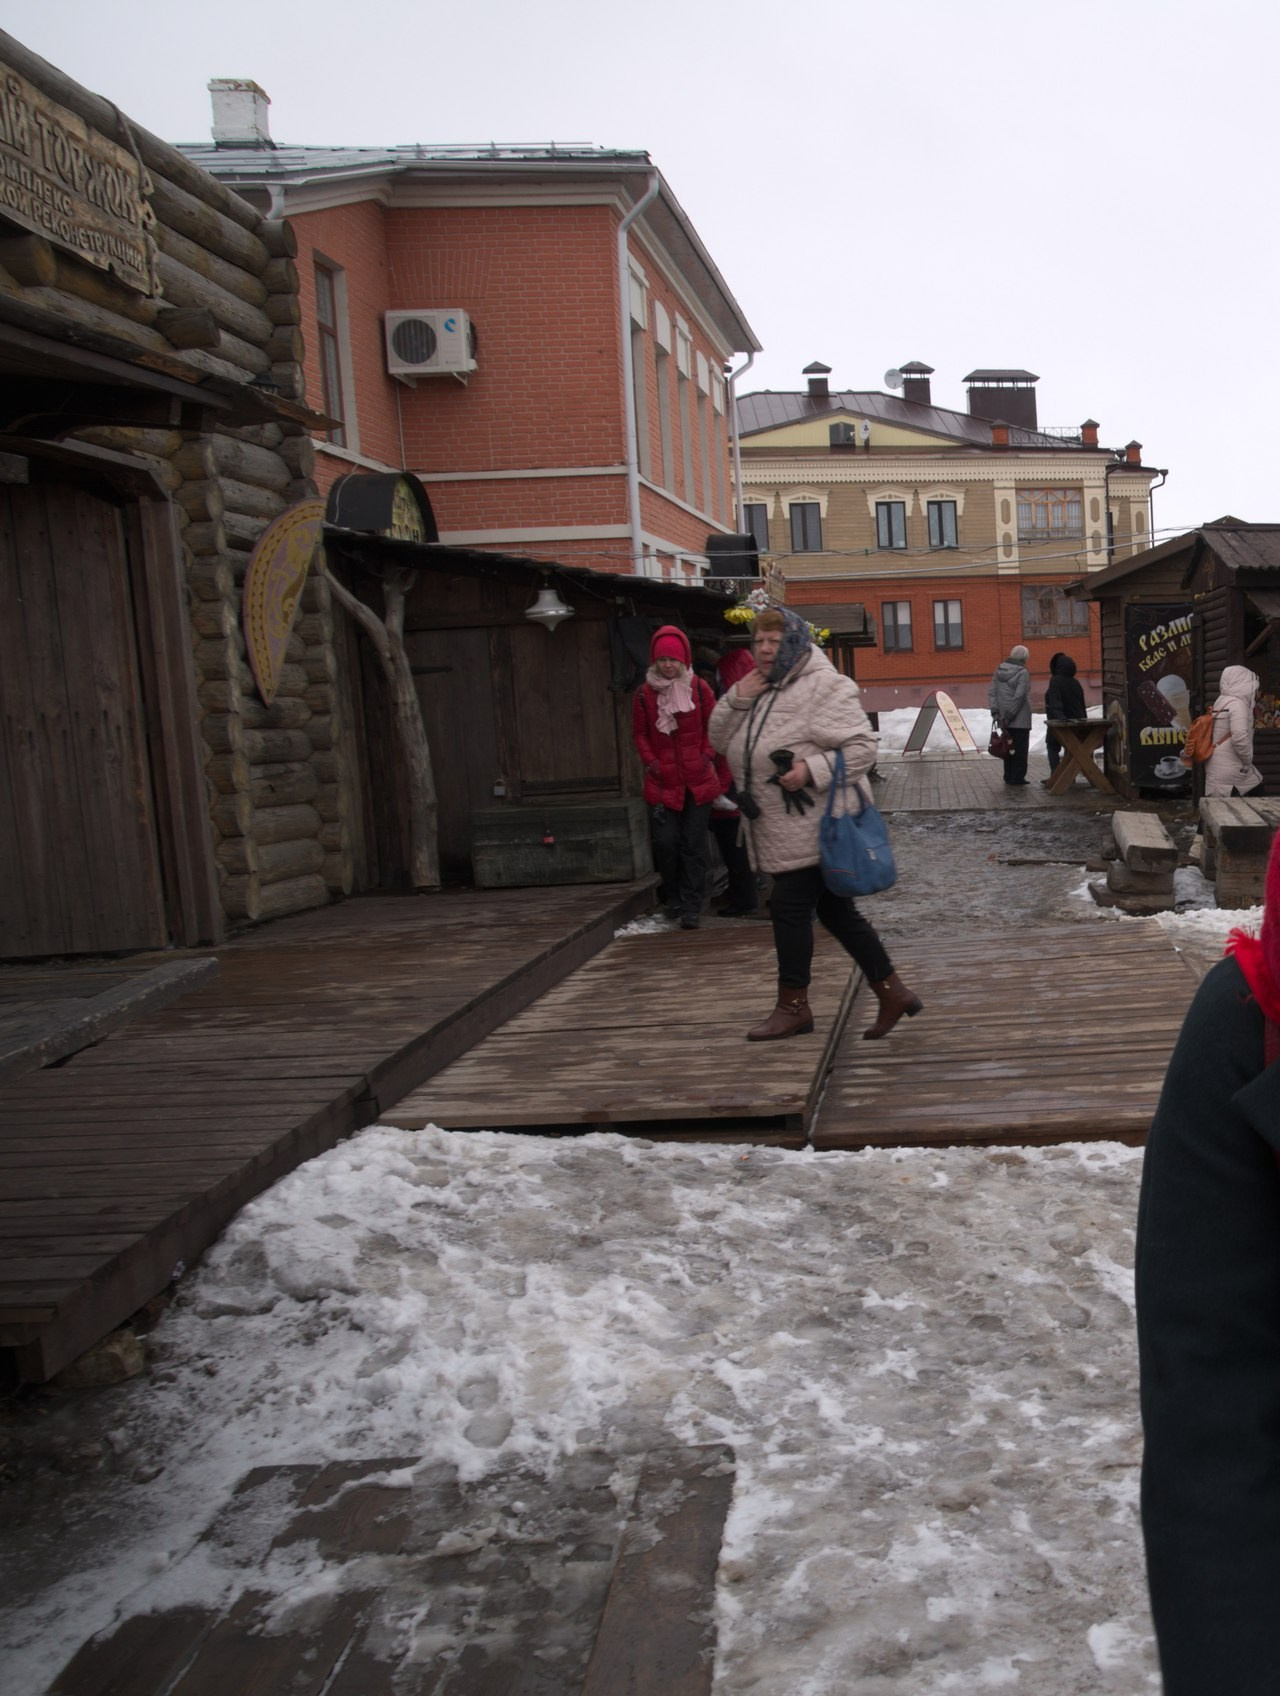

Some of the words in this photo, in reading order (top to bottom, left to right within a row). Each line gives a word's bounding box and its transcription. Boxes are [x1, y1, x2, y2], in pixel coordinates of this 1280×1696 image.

[35, 111, 136, 224] ТОРЖОК
[32, 198, 145, 272] РЕКОНСТРУКЦИИ
[1138, 647, 1167, 672] КВАС
